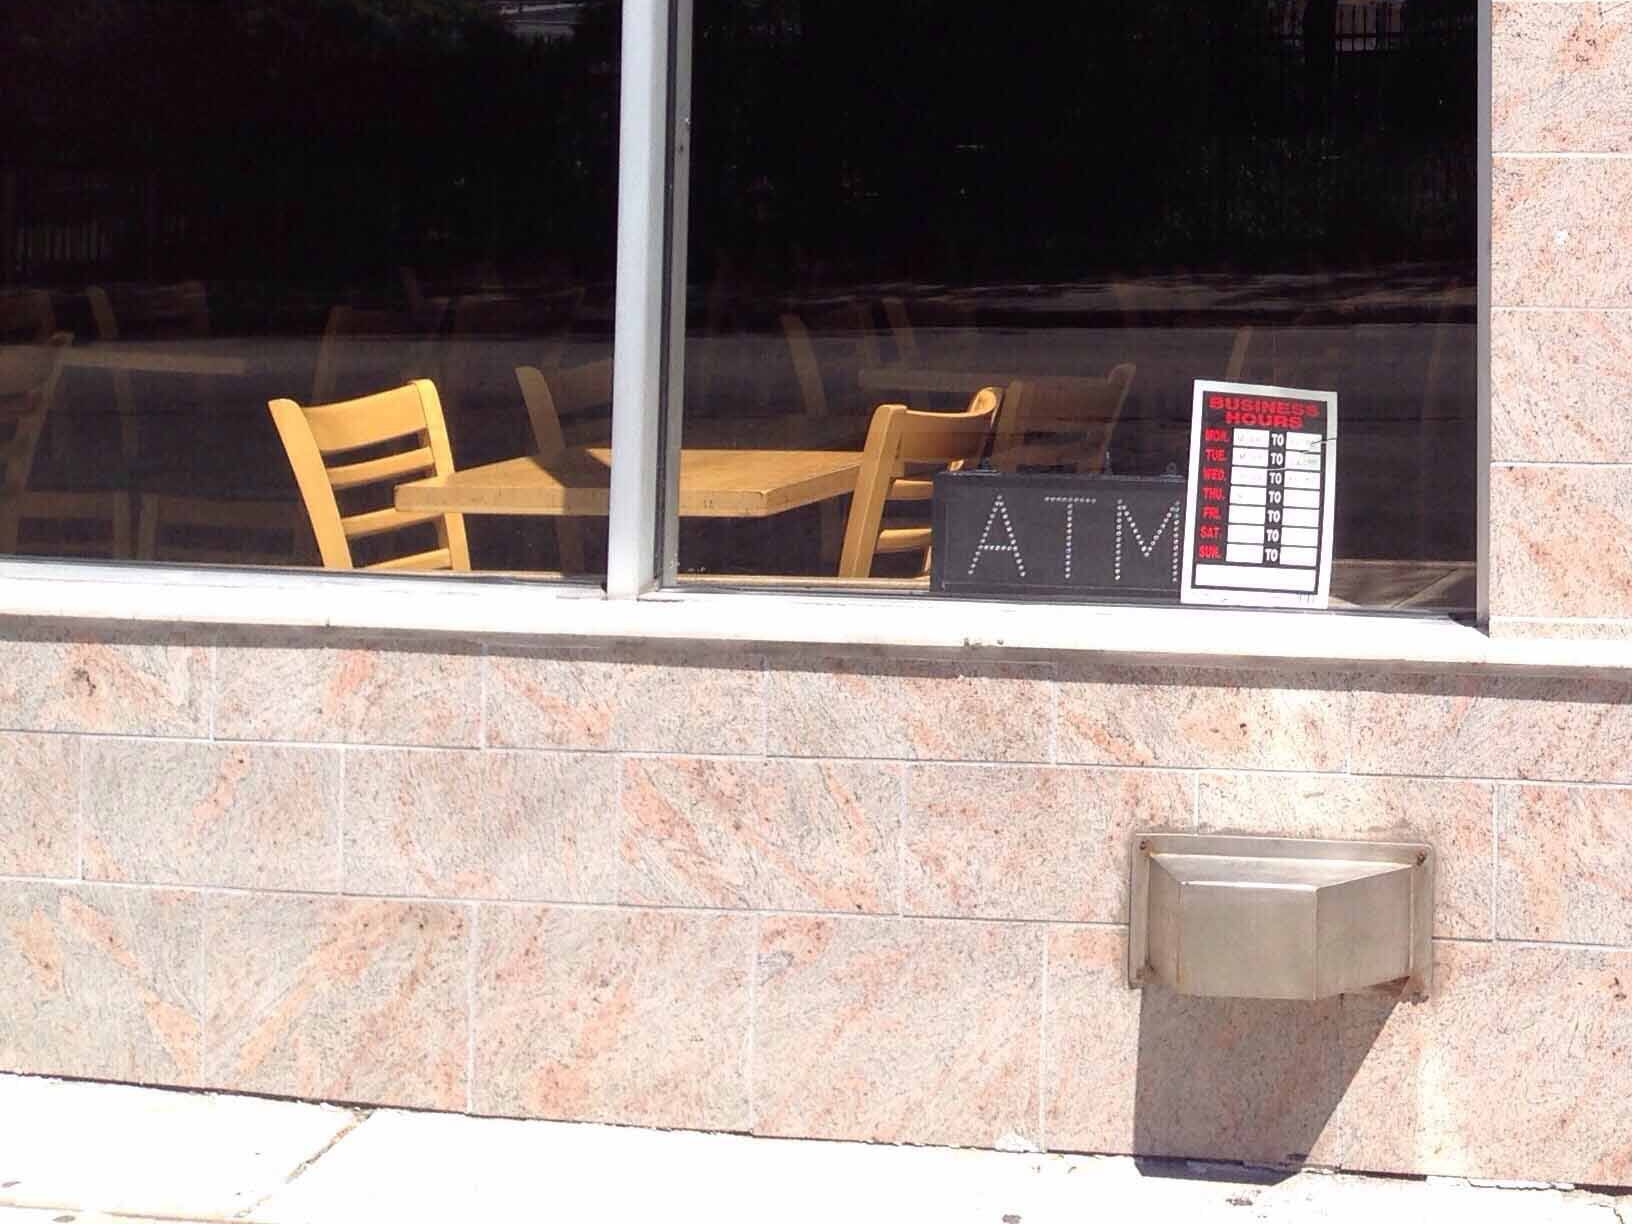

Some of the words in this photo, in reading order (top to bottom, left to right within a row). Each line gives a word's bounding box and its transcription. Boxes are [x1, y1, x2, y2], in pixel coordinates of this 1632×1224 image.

[1208, 394, 1320, 416] BUSINESS
[1224, 411, 1303, 429] HOURS
[1271, 434, 1284, 447] TO
[1270, 453, 1284, 466] TO
[1269, 472, 1282, 485] TO
[1268, 490, 1281, 504] TO
[1267, 510, 1280, 523] TO
[967, 493, 1182, 583] ATM
[1266, 529, 1279, 542] TO
[1265, 549, 1278, 562] TO
